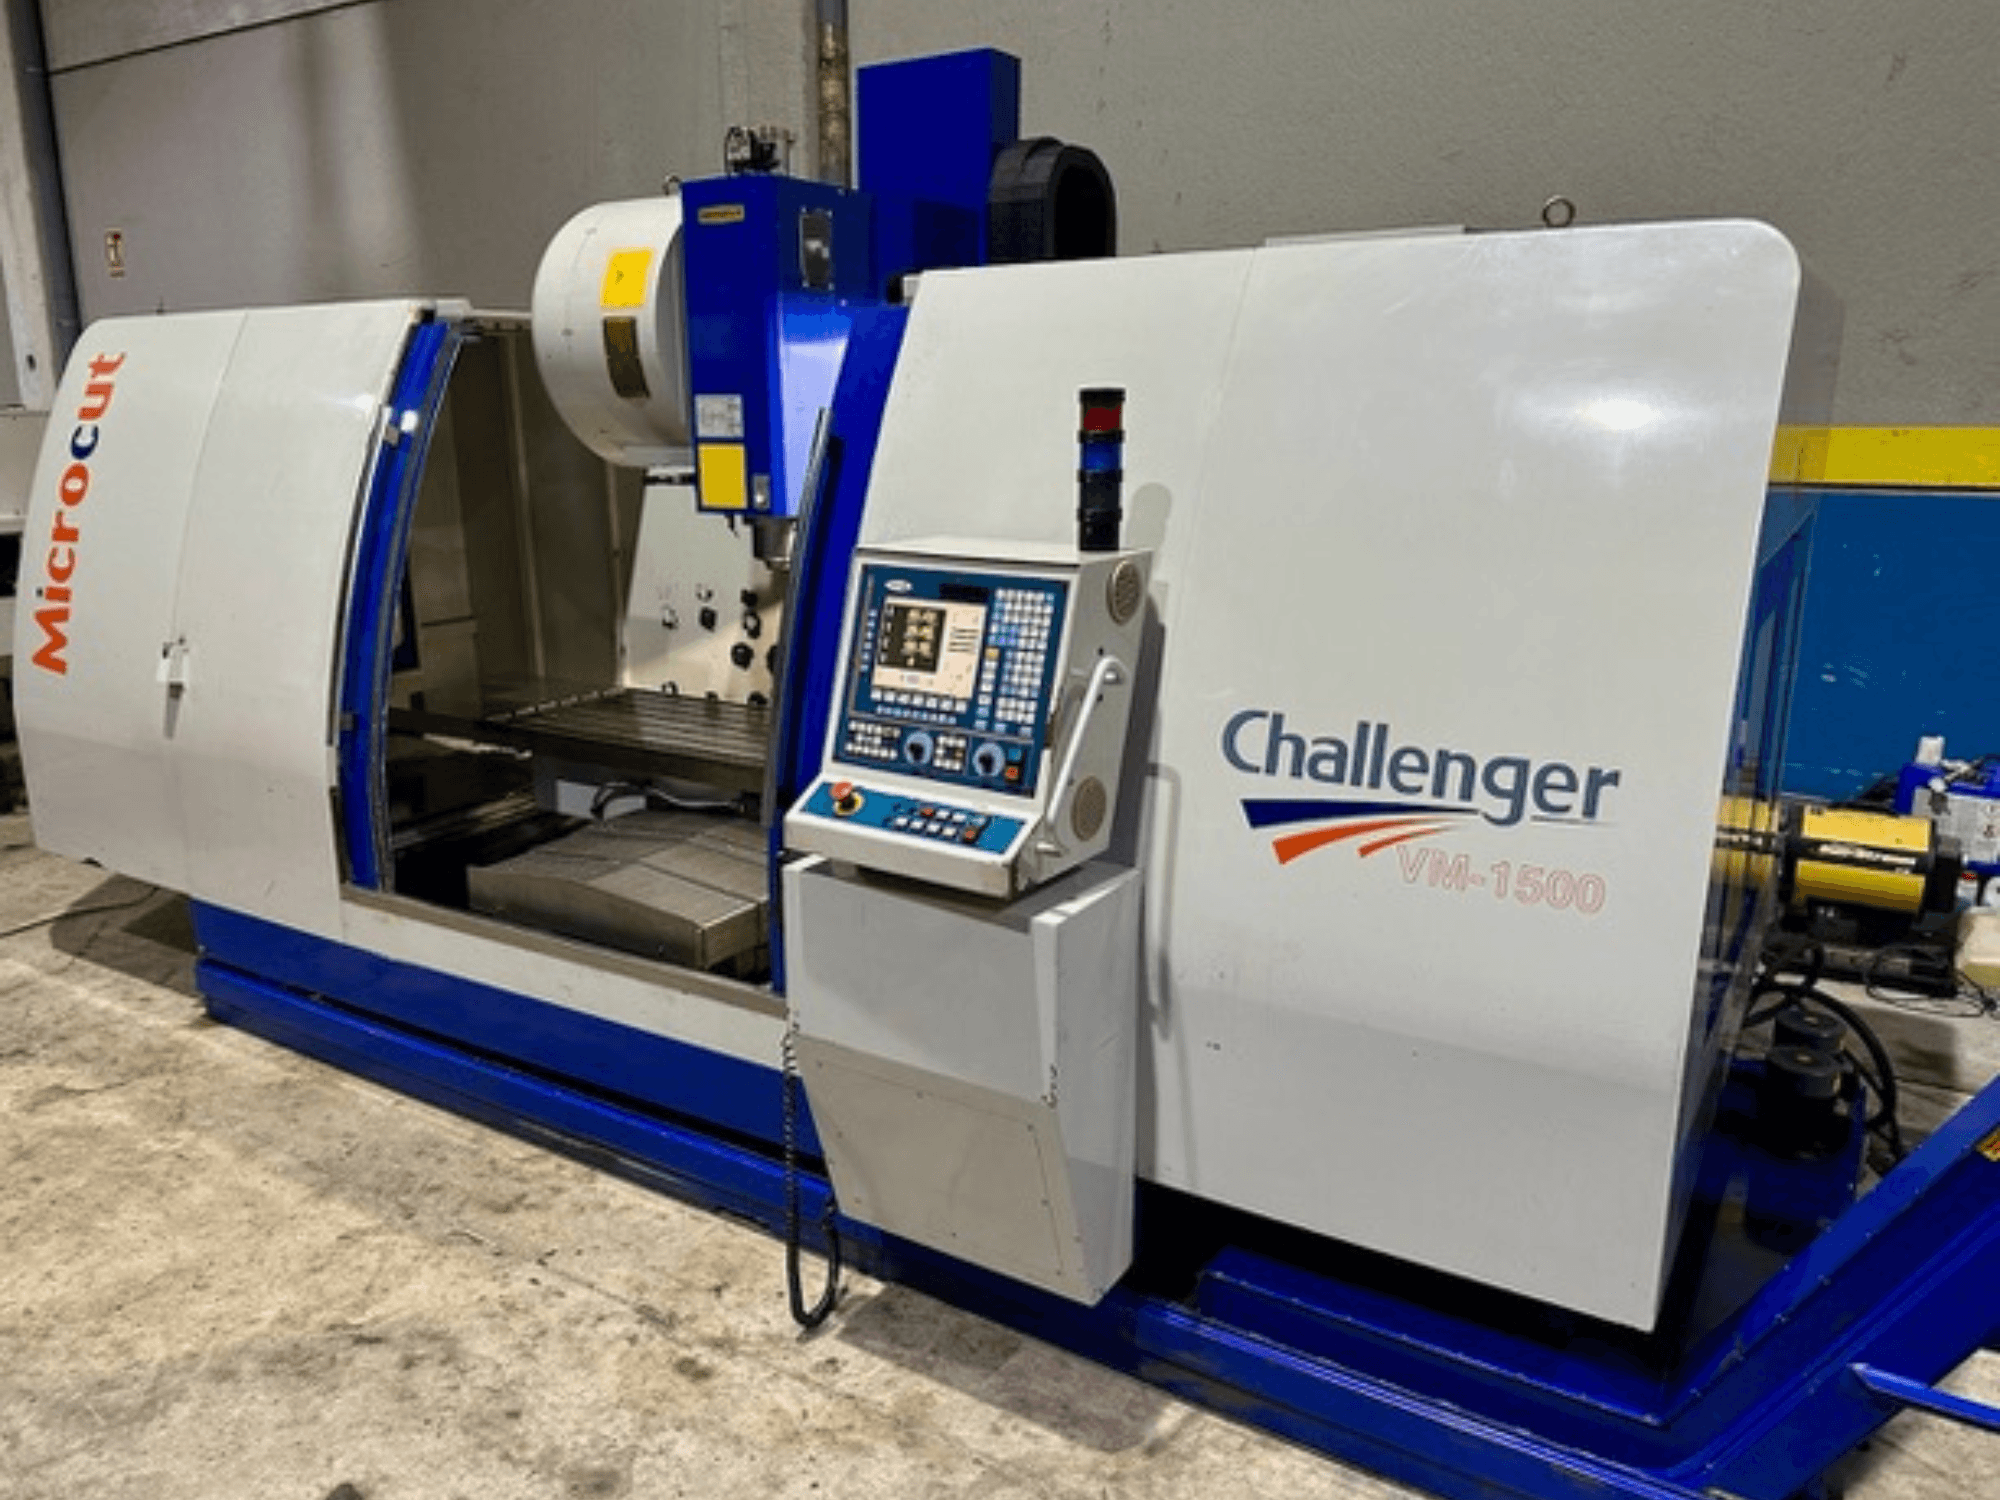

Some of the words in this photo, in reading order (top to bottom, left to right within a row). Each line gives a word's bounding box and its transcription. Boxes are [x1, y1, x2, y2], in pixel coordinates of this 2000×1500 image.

[32, 352, 126, 675] Microcut
[1221, 709, 1622, 826] Challenger
[1398, 845, 1606, 914] VM-1500
